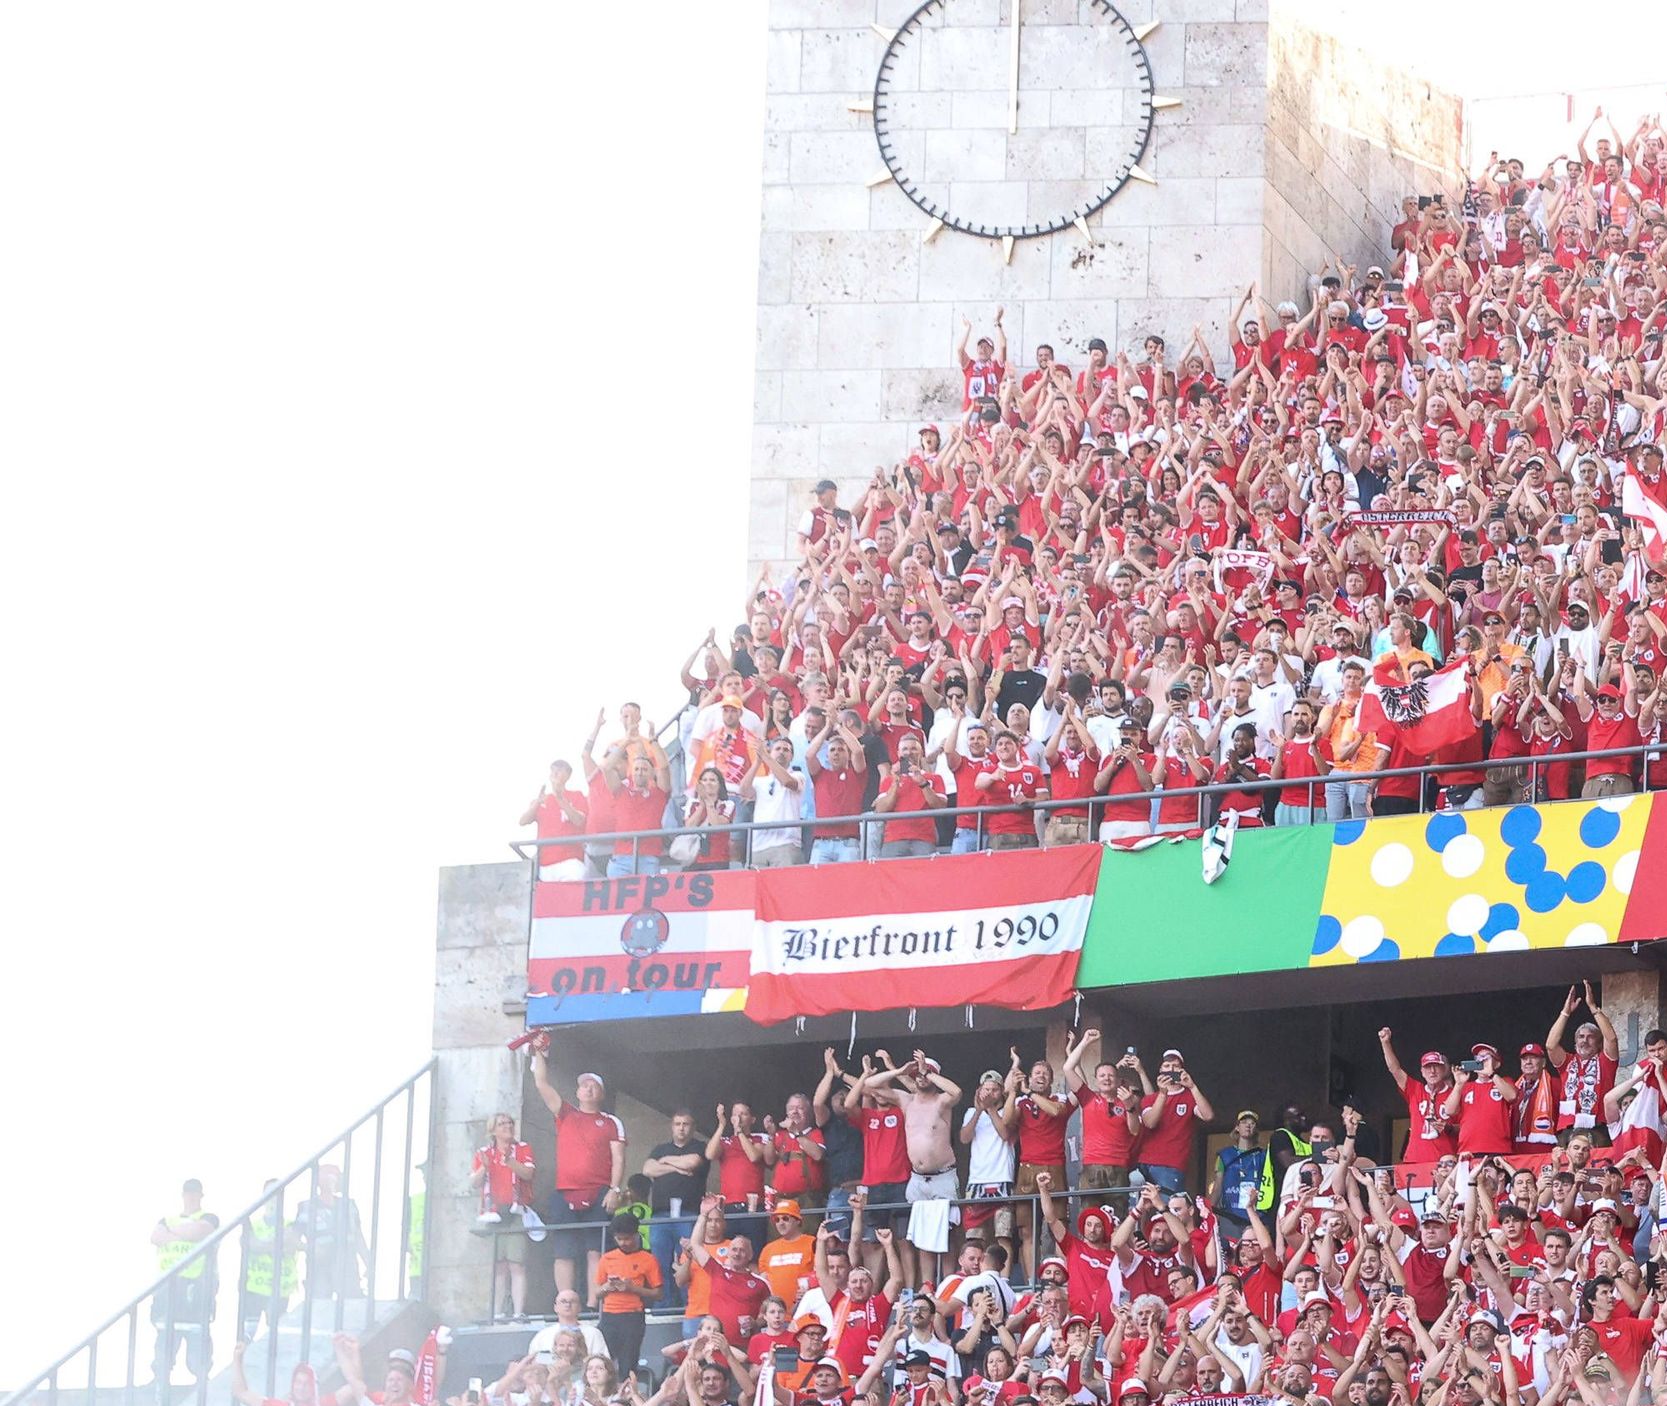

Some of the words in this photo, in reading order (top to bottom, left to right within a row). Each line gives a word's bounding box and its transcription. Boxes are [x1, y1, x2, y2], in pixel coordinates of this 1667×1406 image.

[781, 926, 957, 968] Bierfront
[972, 912, 1060, 952] 1990
[551, 963, 606, 993] on
[1619, 1012, 1639, 1067] J
